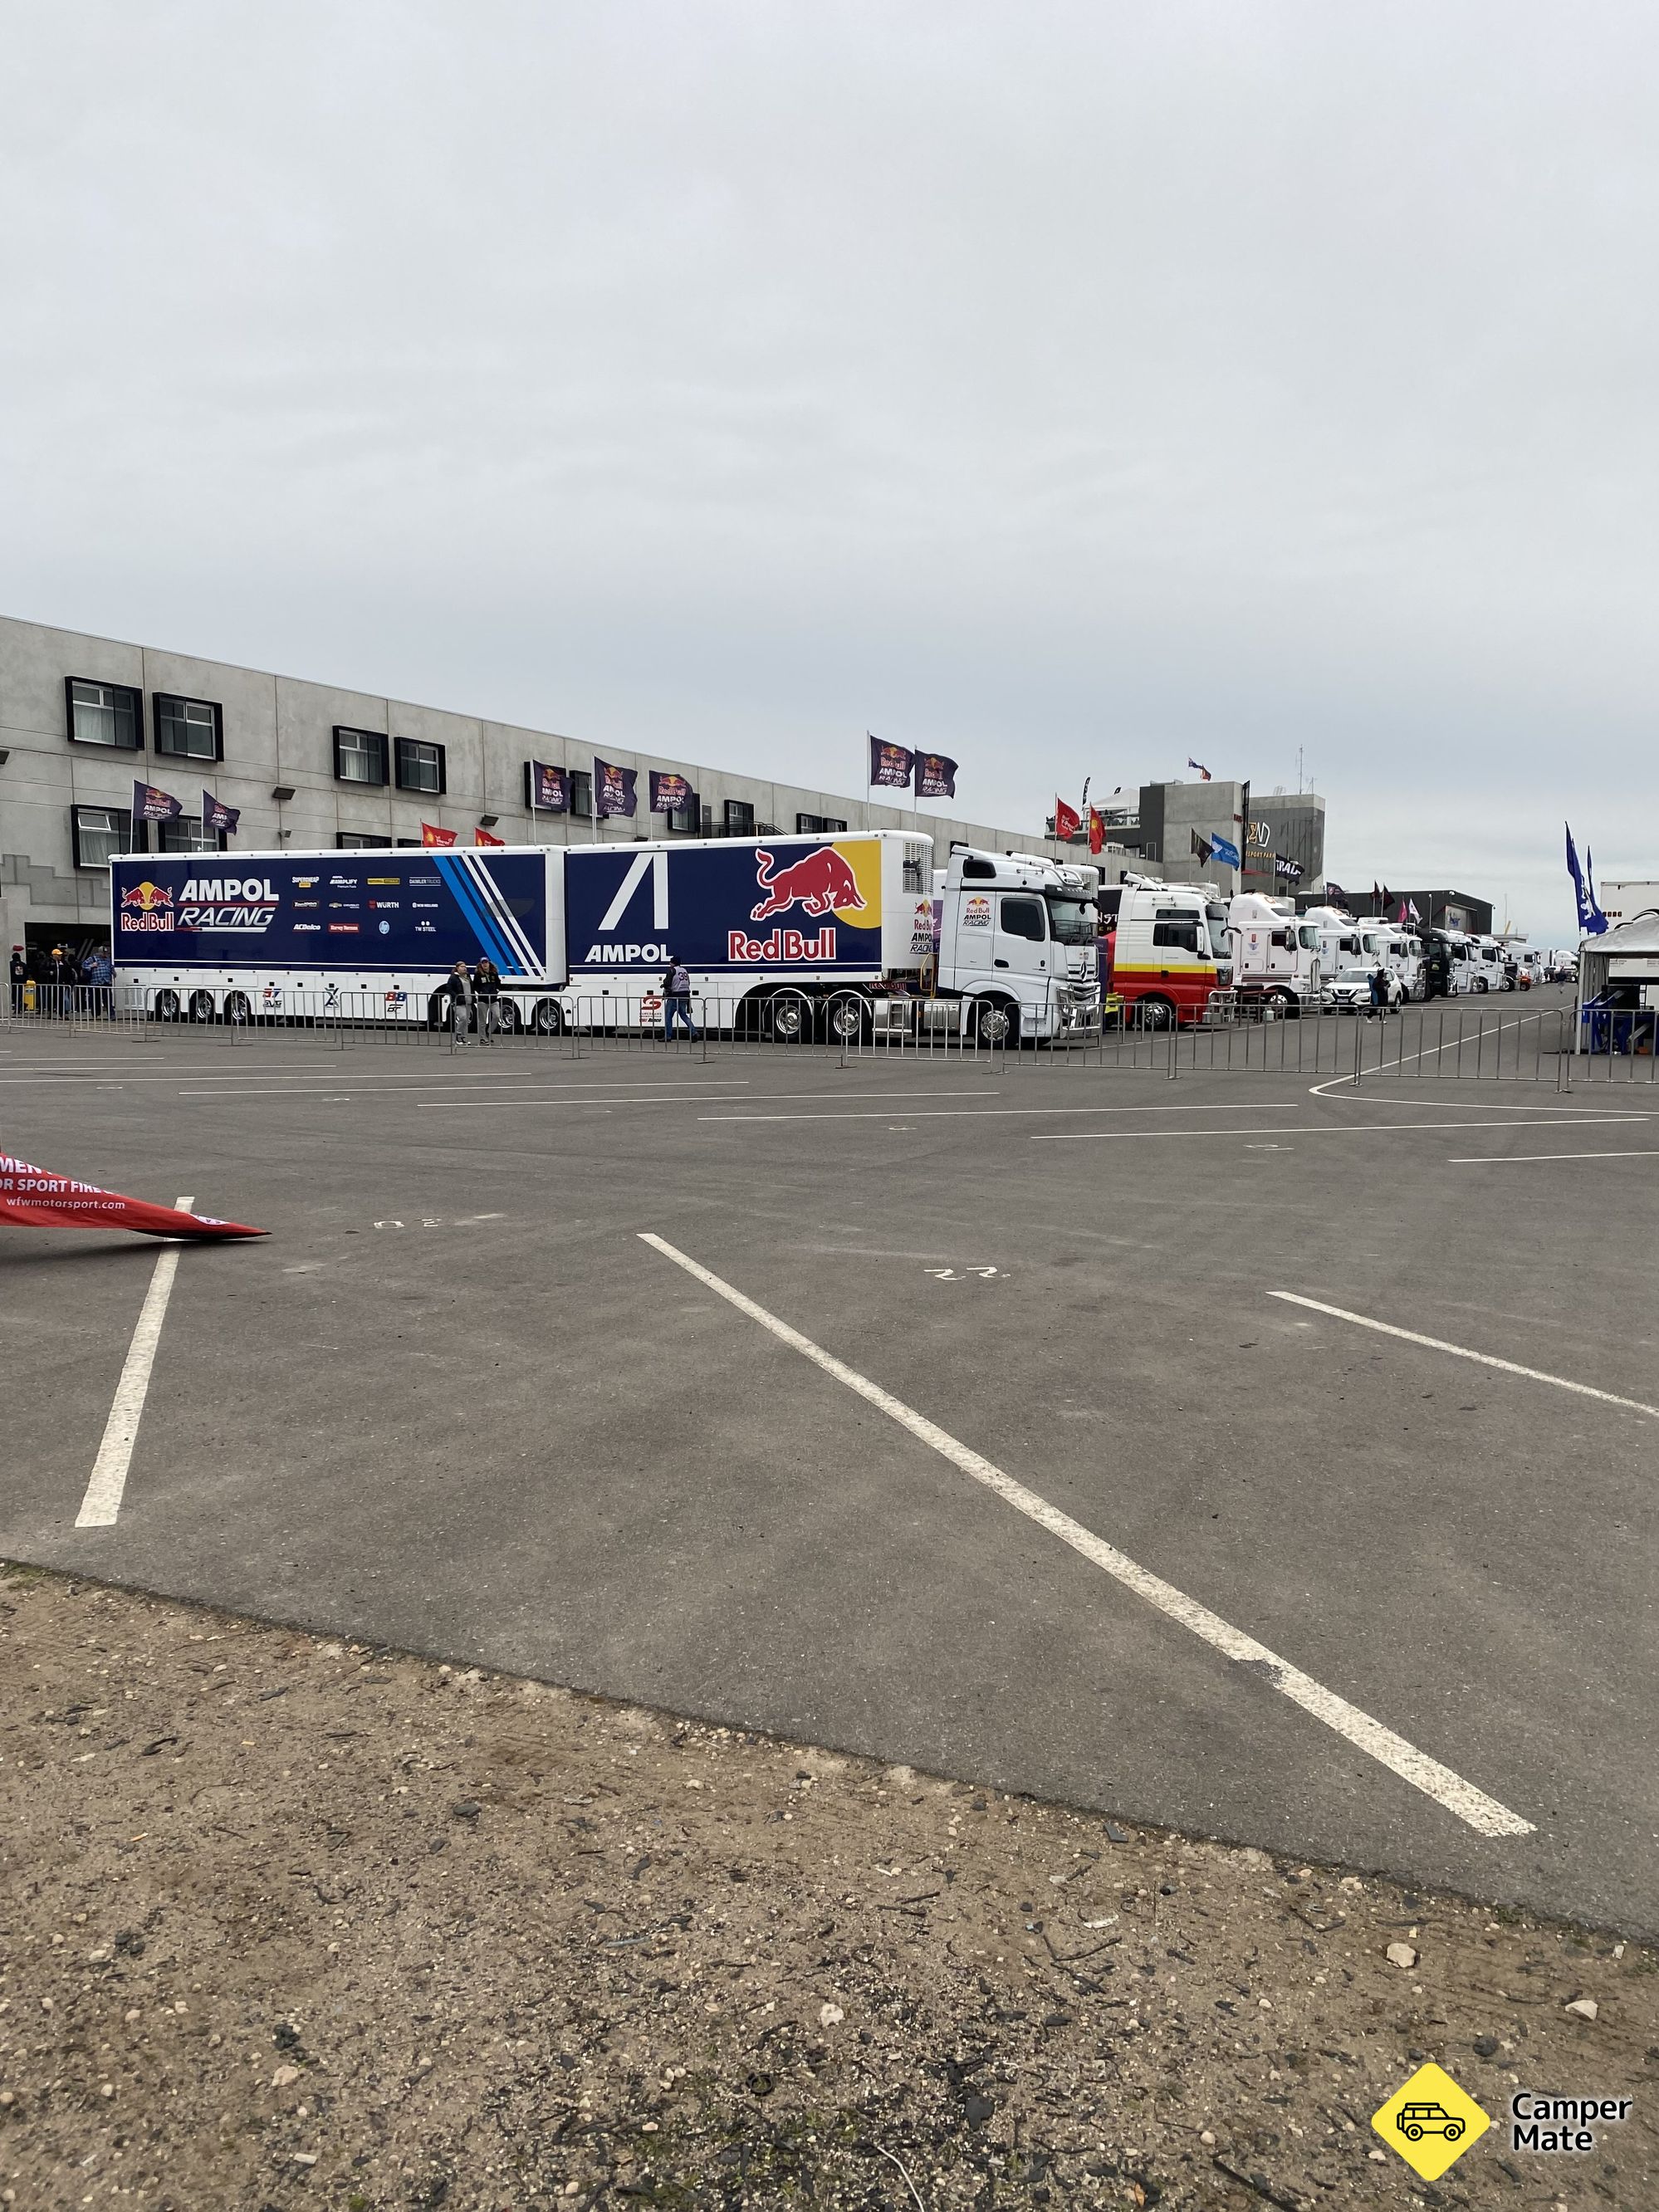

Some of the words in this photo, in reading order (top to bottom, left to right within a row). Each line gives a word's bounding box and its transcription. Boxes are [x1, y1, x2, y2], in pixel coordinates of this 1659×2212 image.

[144, 805, 172, 814] AMPOL
[179, 878, 280, 902] AMPOL
[121, 912, 148, 932] Red
[148, 912, 174, 932] Bull
[177, 907, 276, 927] RACING
[914, 919, 926, 931] Red
[728, 927, 781, 962] Red
[783, 927, 836, 962] Bull
[585, 943, 674, 962] AMPOL
[678, 971, 688, 981] 39
[385, 991, 407, 1001] 88
[17, 1178, 68, 1192] SPORT
[7, 1197, 125, 1210] wfwmotorsport.com
